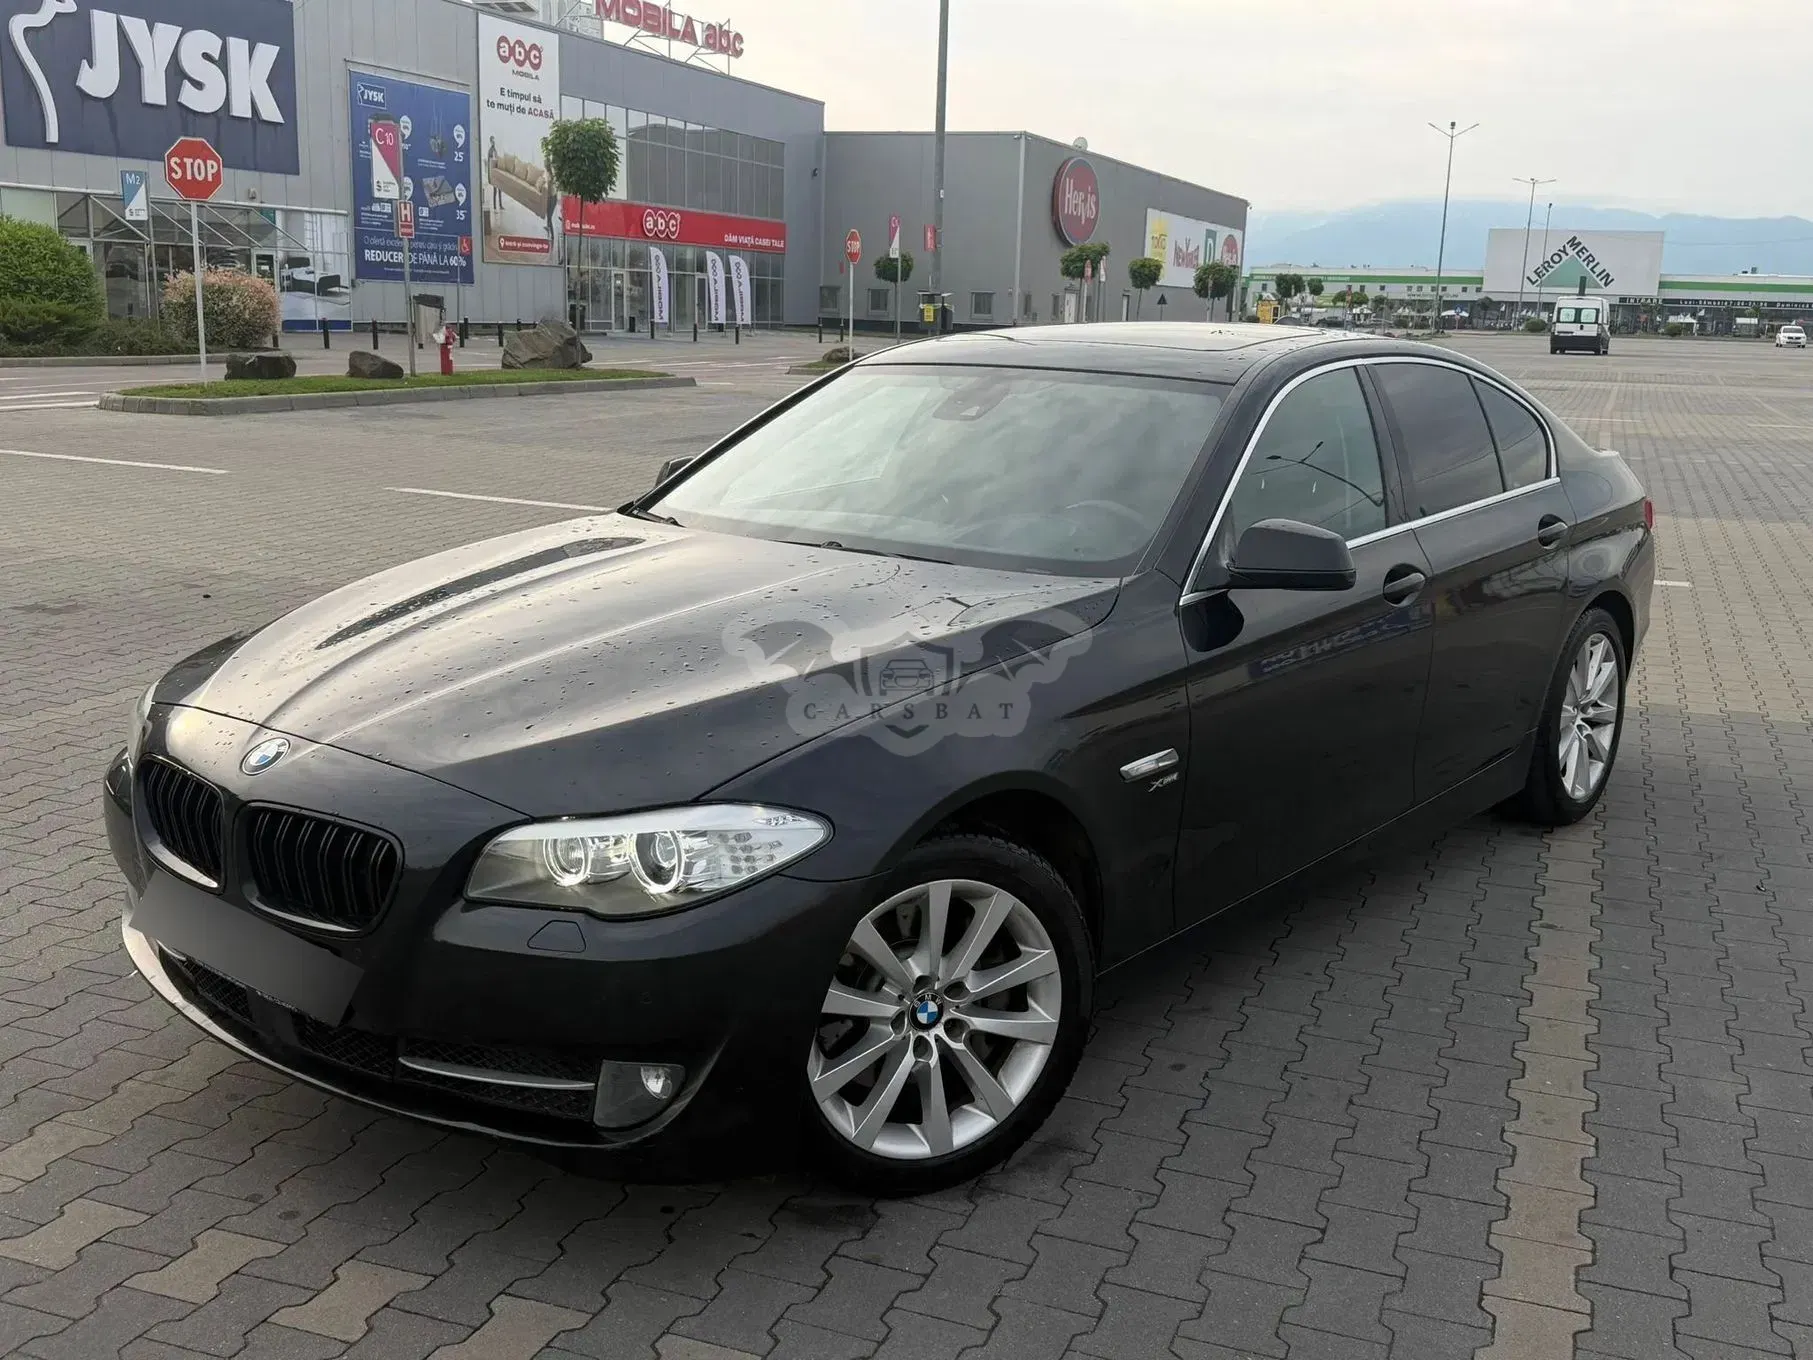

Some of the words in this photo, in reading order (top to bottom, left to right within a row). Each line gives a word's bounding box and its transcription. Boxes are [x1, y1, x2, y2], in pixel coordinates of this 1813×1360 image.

[594, 0, 698, 46] MOBILA
[702, 21, 744, 58] abc
[76, 9, 285, 124] JYSK
[364, 88, 384, 103] JYSK
[500, 87, 505, 96] E
[507, 89, 531, 101] timpul
[486, 99, 495, 108] te
[516, 105, 526, 114] de
[169, 156, 218, 182] STOP
[1064, 177, 1096, 224] Hervis
[400, 203, 411, 221] H
[847, 240, 859, 252] STOP
[439, 255, 449, 265] LA
[1526, 244, 1569, 286] LEROY
[1566, 236, 1615, 288] MERLIN
[913, 994, 942, 1008] BMW
